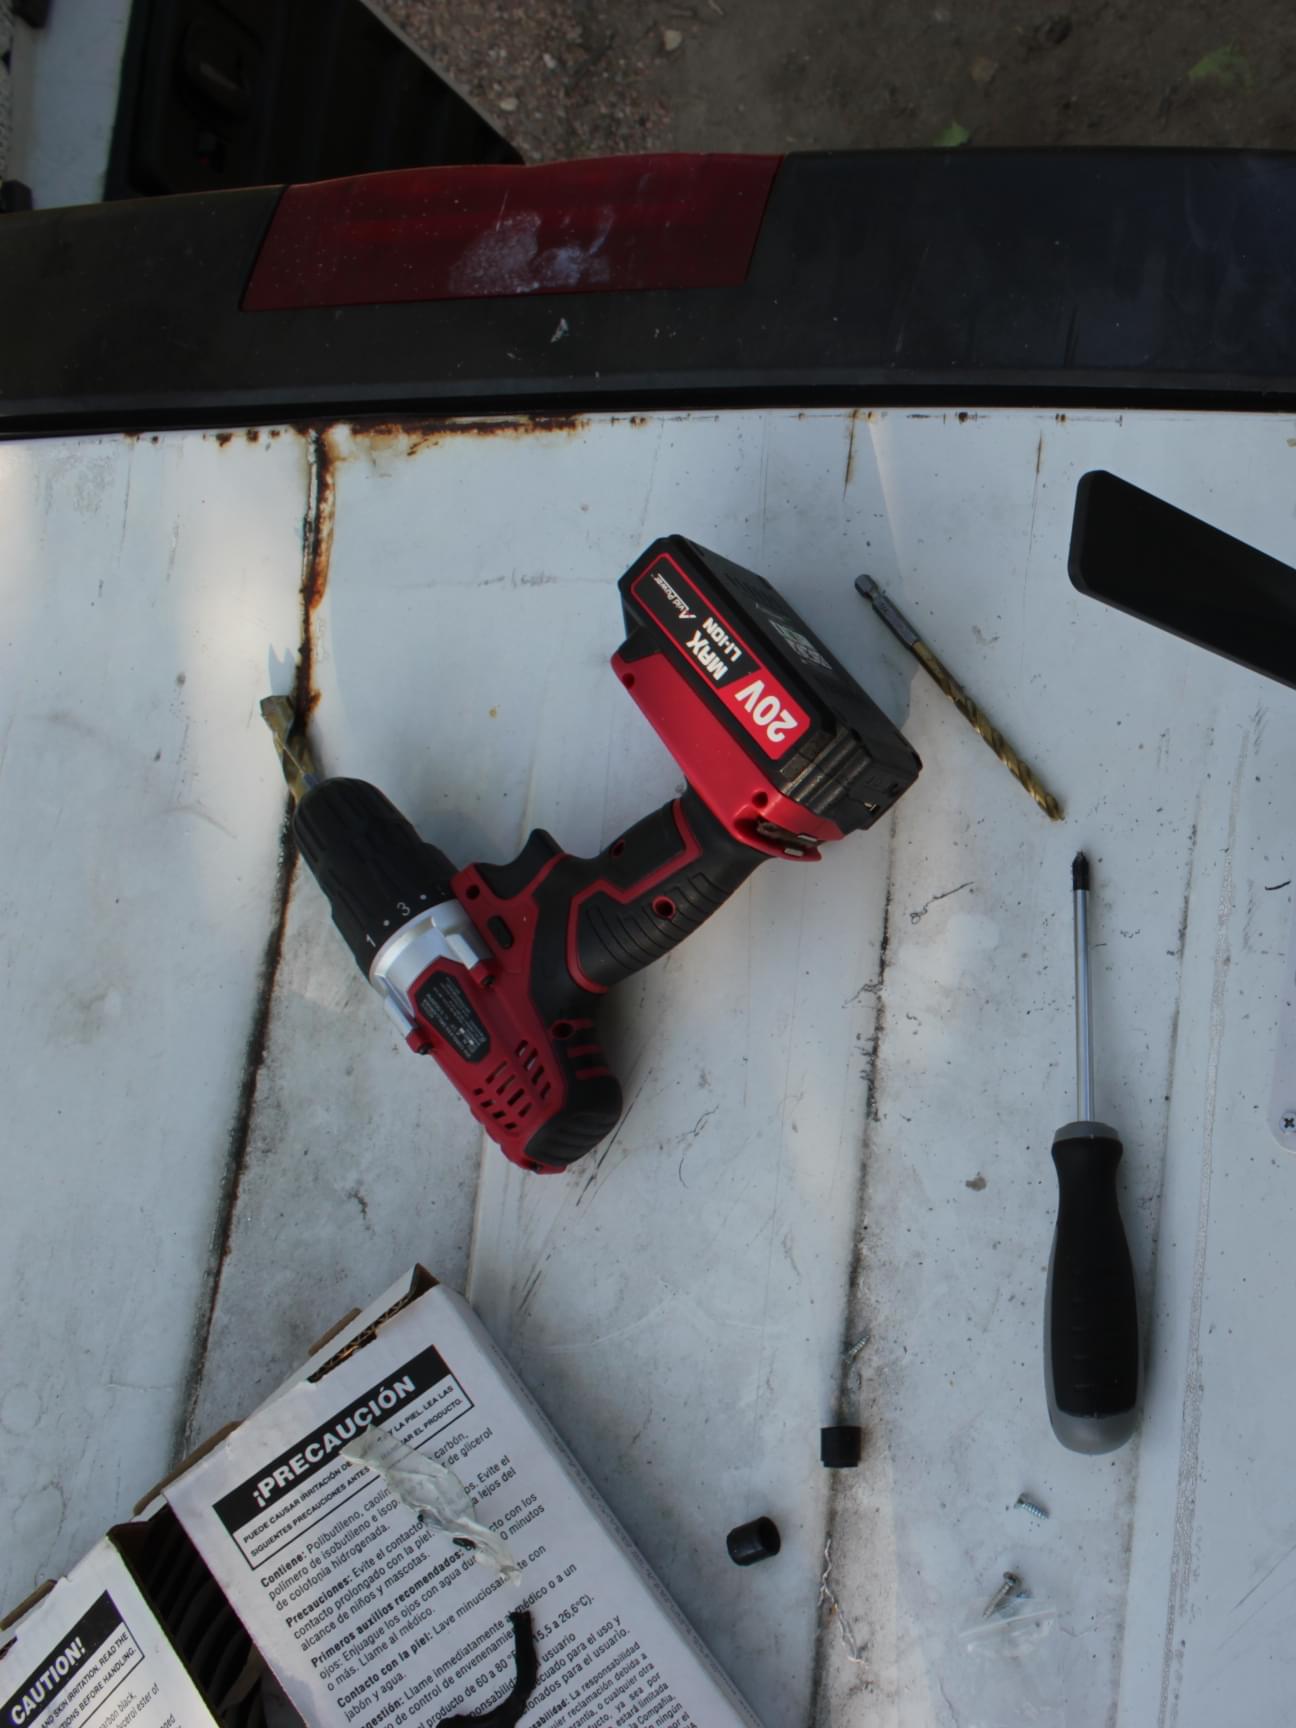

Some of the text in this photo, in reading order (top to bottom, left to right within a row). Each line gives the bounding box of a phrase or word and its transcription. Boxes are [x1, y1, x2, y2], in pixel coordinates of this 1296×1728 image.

[672, 596, 697, 619] Avid
[685, 629, 729, 681] MAX
[702, 617, 742, 662] LI-ION
[734, 679, 798, 743] 20V
[396, 901, 411, 917] 3
[366, 934, 377, 948] 1
[393, 1421, 406, 1433] LA
[422, 1397, 439, 1411] LEA
[438, 1385, 454, 1400] LAS
[413, 1398, 463, 1437] EL PRODUCTO.
[252, 1375, 416, 1508] ¡PRECAUCIÓN
[433, 1433, 469, 1461] carbón,
[447, 1453, 460, 1466] de
[459, 1426, 494, 1458] glicerol
[476, 1463, 501, 1484] Evite
[500, 1454, 511, 1467] el
[242, 1521, 270, 1544] PUEDE
[268, 1498, 301, 1525] CAUSAR
[299, 1468, 342, 1502] IRRITACIÓN
[477, 1466, 517, 1500] lejos del
[250, 1466, 370, 1557] SIGUIENTES PRECAUCIONES ANTES
[508, 1504, 545, 1536] minutos
[260, 1551, 308, 1588] Contiene:
[305, 1511, 365, 1554] Polibutileno,
[275, 1598, 289, 1612] de
[330, 1524, 392, 1569] hidrogenada.
[309, 1556, 322, 1569] de
[320, 1520, 371, 1560] isobutileno
[371, 1514, 379, 1523] e
[285, 1518, 424, 1628] Precauciones: Evite el contacto
[293, 1529, 436, 1640] contacto prolongado con la piel.
[310, 1631, 356, 1668] Primeros
[355, 1602, 395, 1635] auxilios
[394, 1548, 465, 1606] recomendados:
[504, 1505, 523, 1522] con
[520, 1493, 538, 1508] los
[300, 1621, 337, 1652] alcance
[336, 1611, 350, 1625] de
[349, 1591, 377, 1615] niños
[375, 1584, 384, 1596] y
[383, 1552, 431, 1589] mascotas.
[319, 1568, 462, 1680] ojos: Enjuague los ojos con agua
[336, 1673, 380, 1709] Contacto
[380, 1659, 399, 1676] con
[397, 1650, 411, 1662] la
[410, 1631, 435, 1655] piel:
[431, 1615, 456, 1635] Lave
[528, 1545, 547, 1563] con
[552, 1620, 560, 1629] a
[327, 1607, 437, 1692] o más. Llame al médico.
[361, 1697, 406, 1728] gestión:
[403, 1674, 434, 1701] Llame
[432, 1620, 505, 1678] inmediatamente
[547, 1579, 556, 1589] o
[555, 1574, 564, 1583] a
[563, 1563, 577, 1577] un
[539, 1633, 576, 1663] usuario
[561, 1663, 584, 1685] para
[583, 1653, 593, 1666] el
[592, 1628, 631, 1659] usuario.
[565, 1642, 588, 1663] para
[586, 1632, 597, 1646] el
[596, 1621, 614, 1638] uso
[612, 1615, 621, 1627] y
[11, 1636, 86, 1725] CAUTION!
[52, 1699, 69, 1718] SKIN
[98, 1644, 117, 1667] READ
[114, 1631, 129, 1648] THE
[78, 1681, 105, 1712] BEFORE
[102, 1647, 138, 1684] HANDLING.
[343, 1672, 409, 1723] jabón y agua.
[425, 1694, 465, 1728] producto
[464, 1684, 477, 1697] de
[475, 1673, 489, 1688] 60
[488, 1670, 497, 1679] a
[494, 1658, 509, 1673] 80
[567, 1652, 648, 1719] reclamación debida a
[568, 1689, 582, 1701] La
[580, 1641, 641, 1692] responsabilidad
[597, 1702, 604, 1711] o
[603, 1674, 638, 1706] cualquier
[638, 1662, 655, 1678] otra
[614, 1700, 626, 1713] ya
[628, 1687, 644, 1701] sea
[646, 1671, 661, 1689] por
[394, 1712, 408, 1726] de
[408, 1683, 443, 1716] control
[441, 1676, 455, 1689] de
[655, 1702, 683, 1727] ningún
